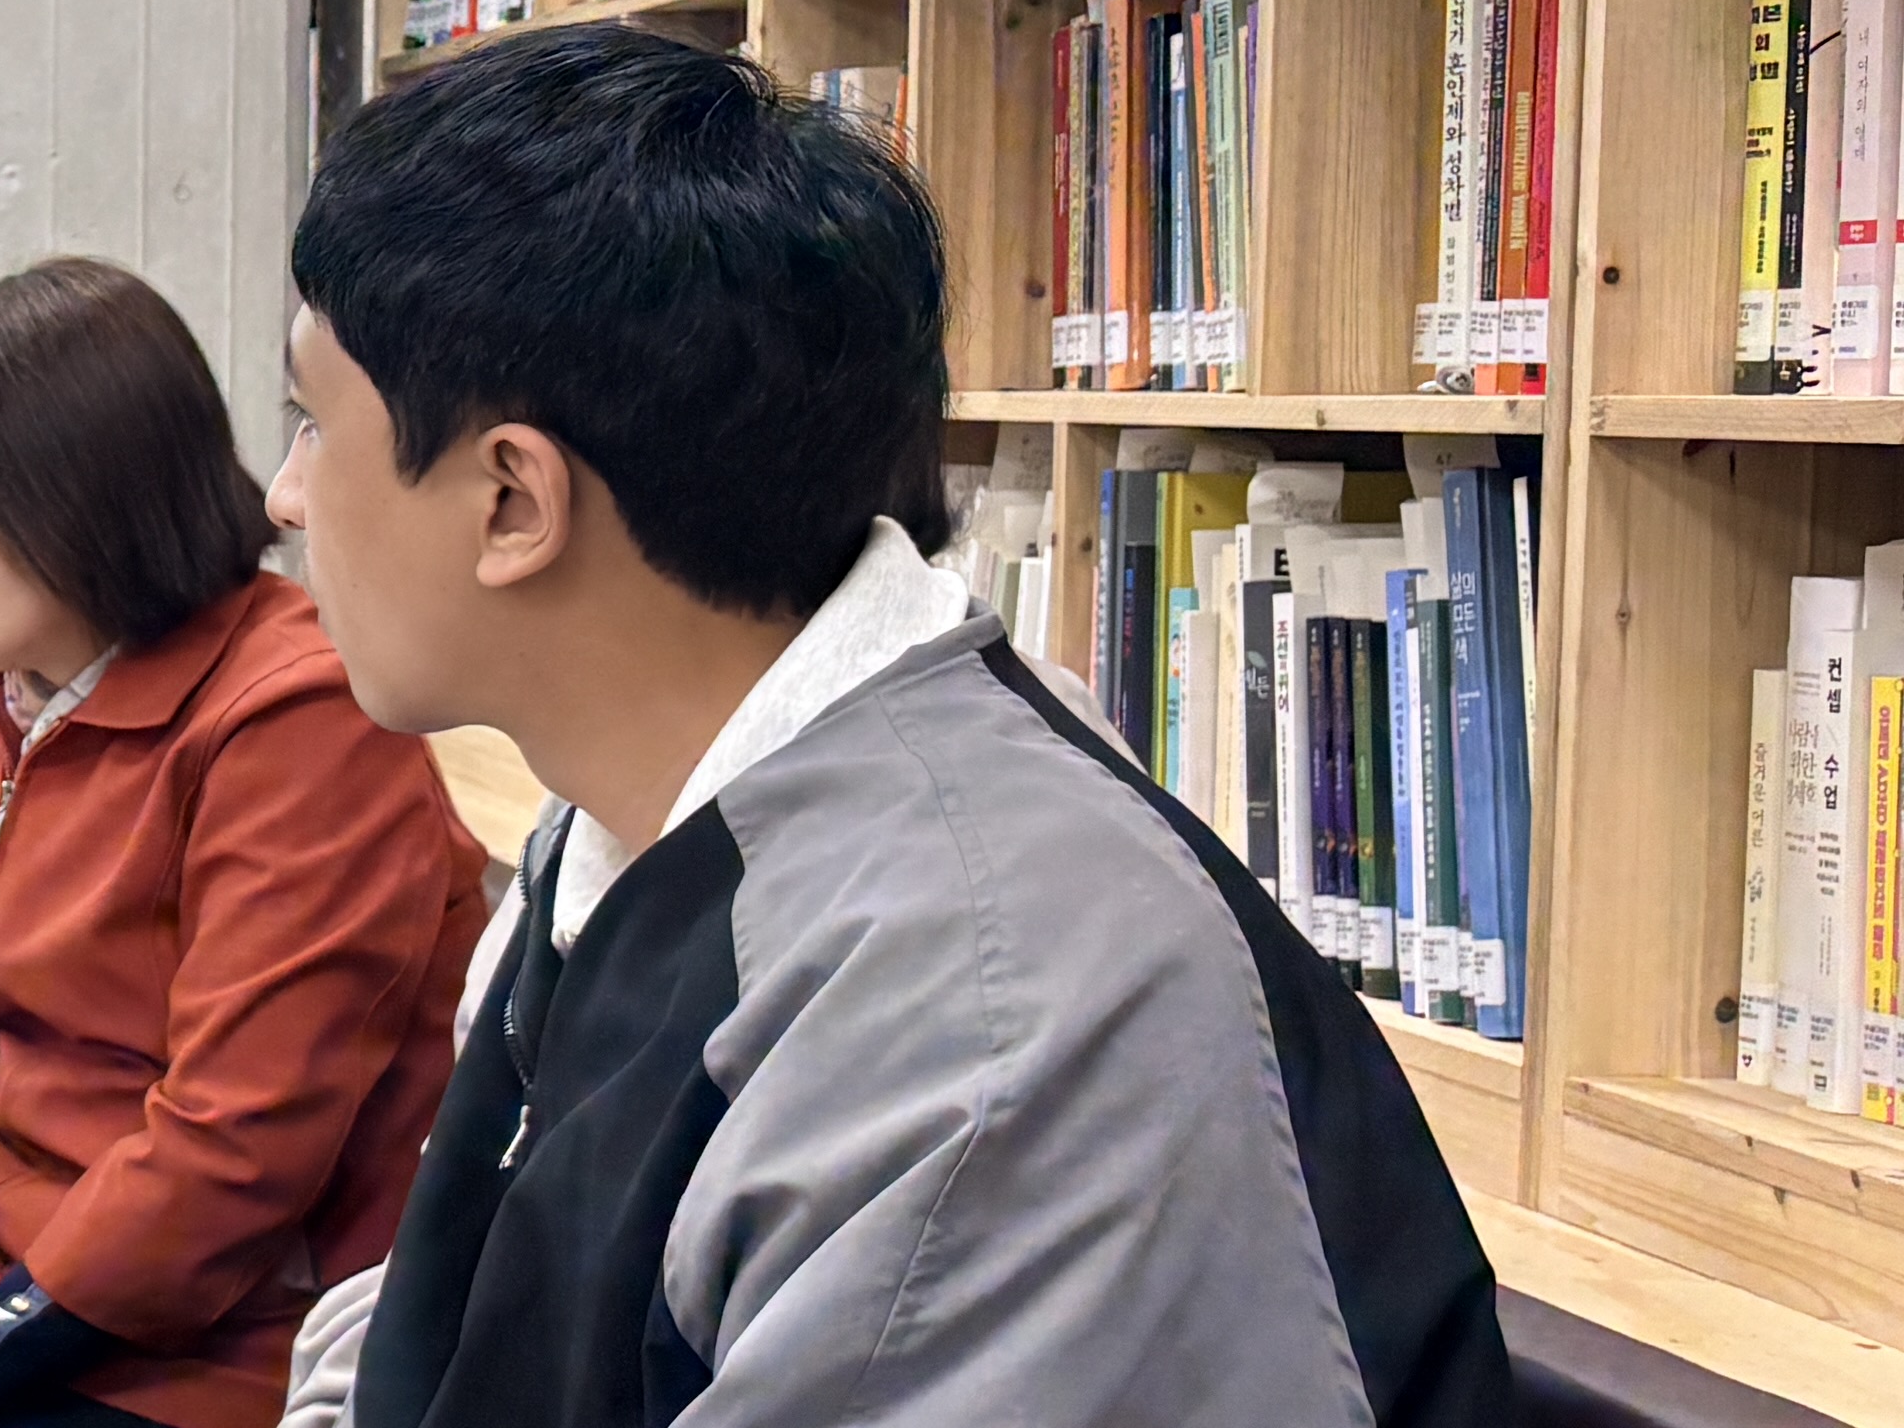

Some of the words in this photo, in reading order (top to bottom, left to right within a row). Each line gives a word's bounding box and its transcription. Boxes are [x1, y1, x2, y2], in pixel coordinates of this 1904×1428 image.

[1444, 52, 1467, 146] 혼인제와
[1442, 150, 1466, 222] 성차별
[1509, 195, 1530, 251] WOMEN
[1450, 570, 1477, 600] 삶의
[1452, 601, 1476, 634] 모든
[1454, 636, 1469, 665] 색
[1826, 657, 1843, 714] 컨셉
[1751, 741, 1767, 803] 즐거운
[1823, 753, 1840, 810] 수업
[1750, 809, 1765, 848] 어른
